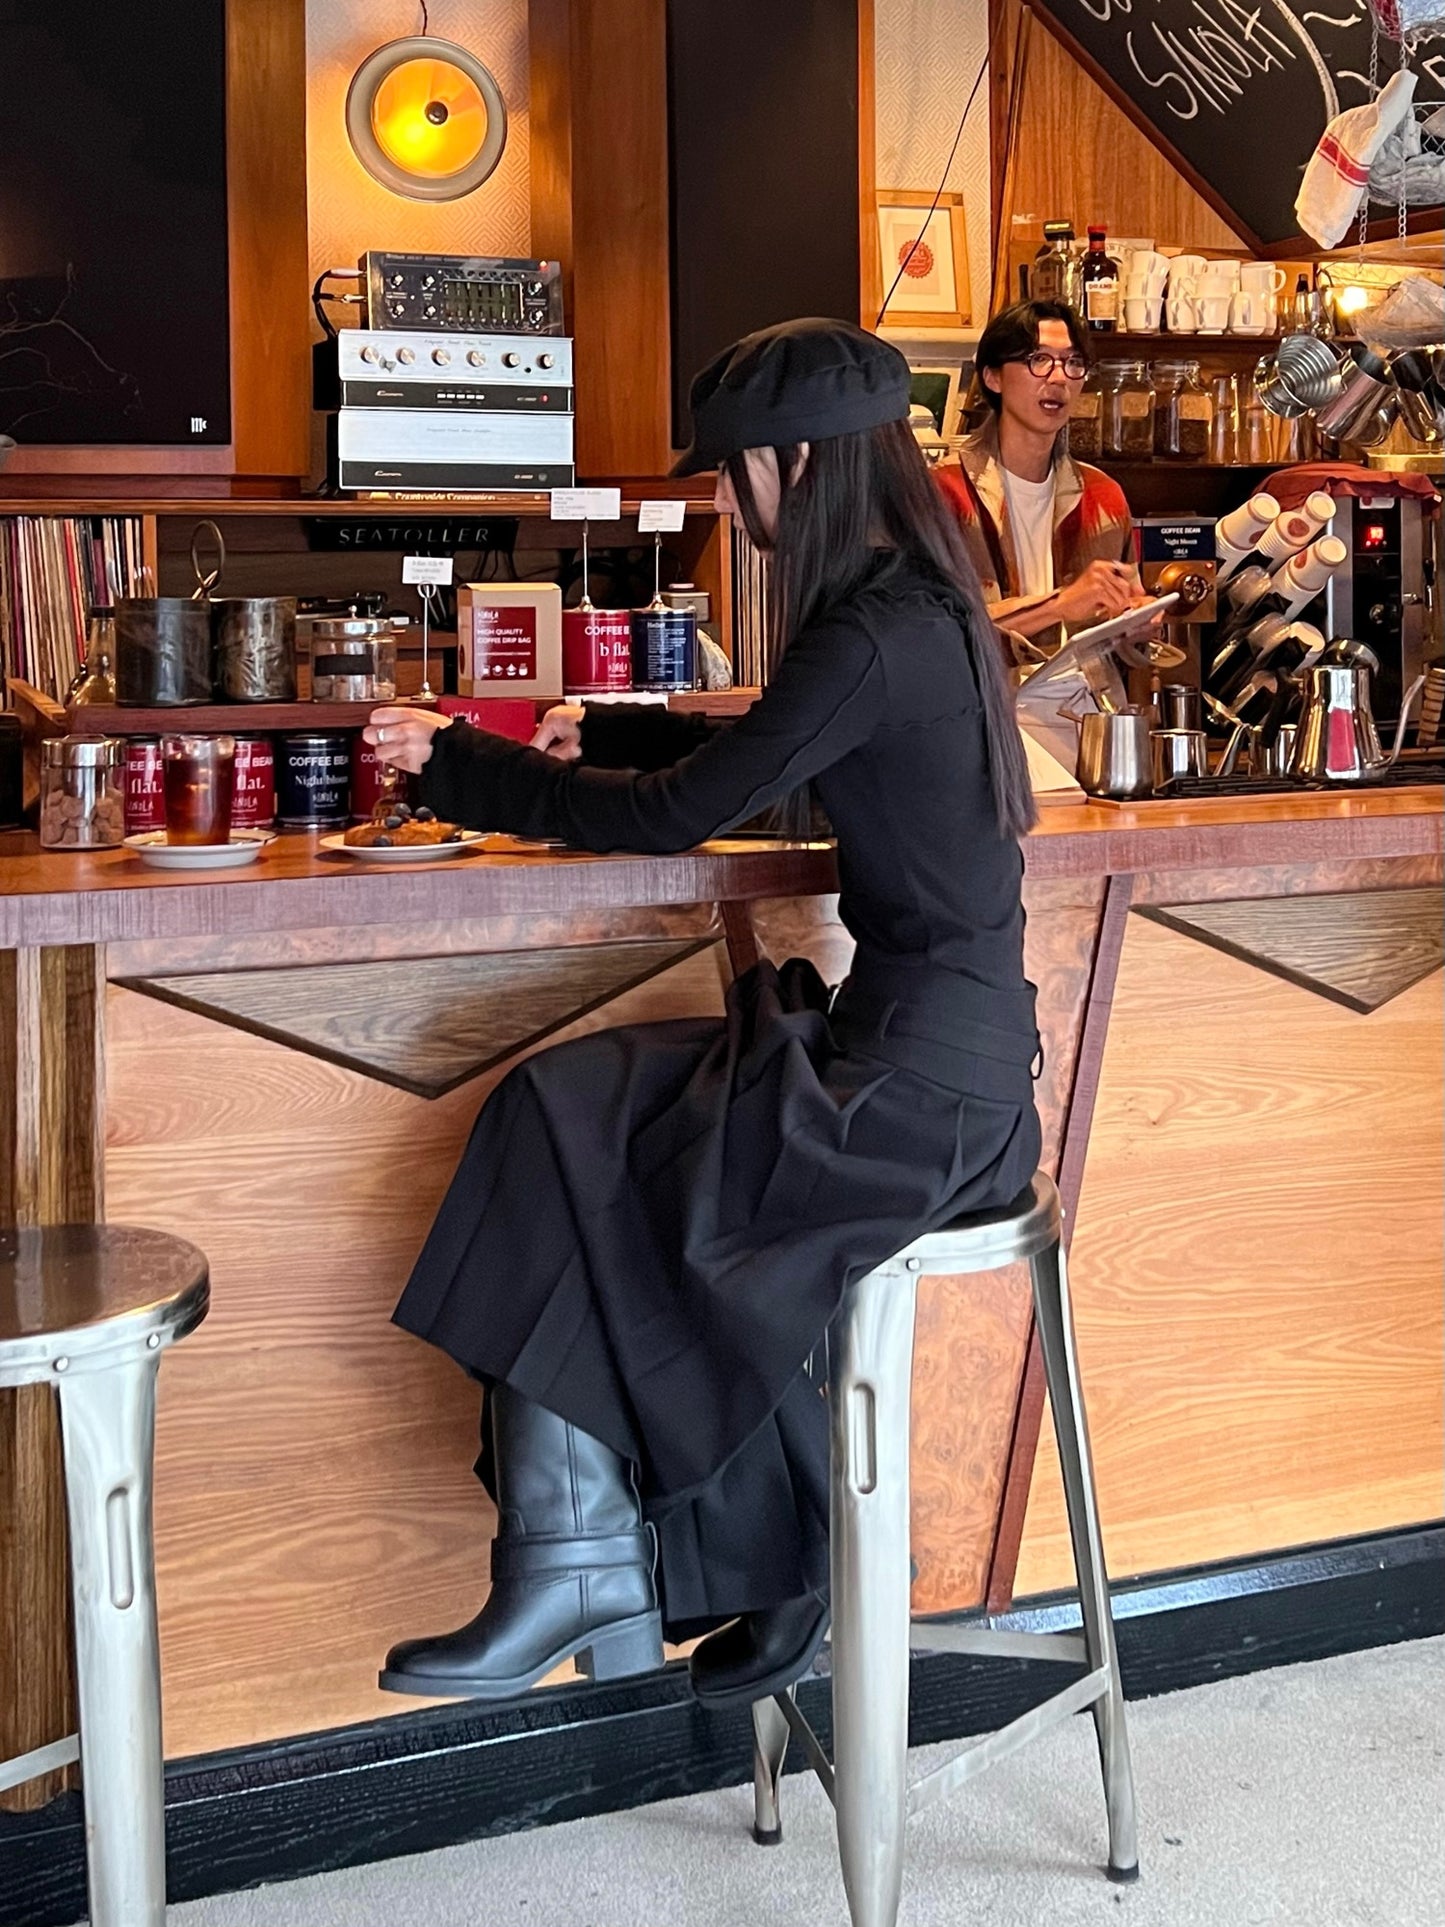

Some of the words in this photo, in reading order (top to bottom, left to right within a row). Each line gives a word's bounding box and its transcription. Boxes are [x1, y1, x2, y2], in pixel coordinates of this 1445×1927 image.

[338, 528, 489, 545] SEATOLLER
[495, 628, 523, 636] QUALITY
[584, 625, 623, 636] COFFEE
[288, 755, 332, 767] COFFEE
[295, 774, 323, 789] Night
